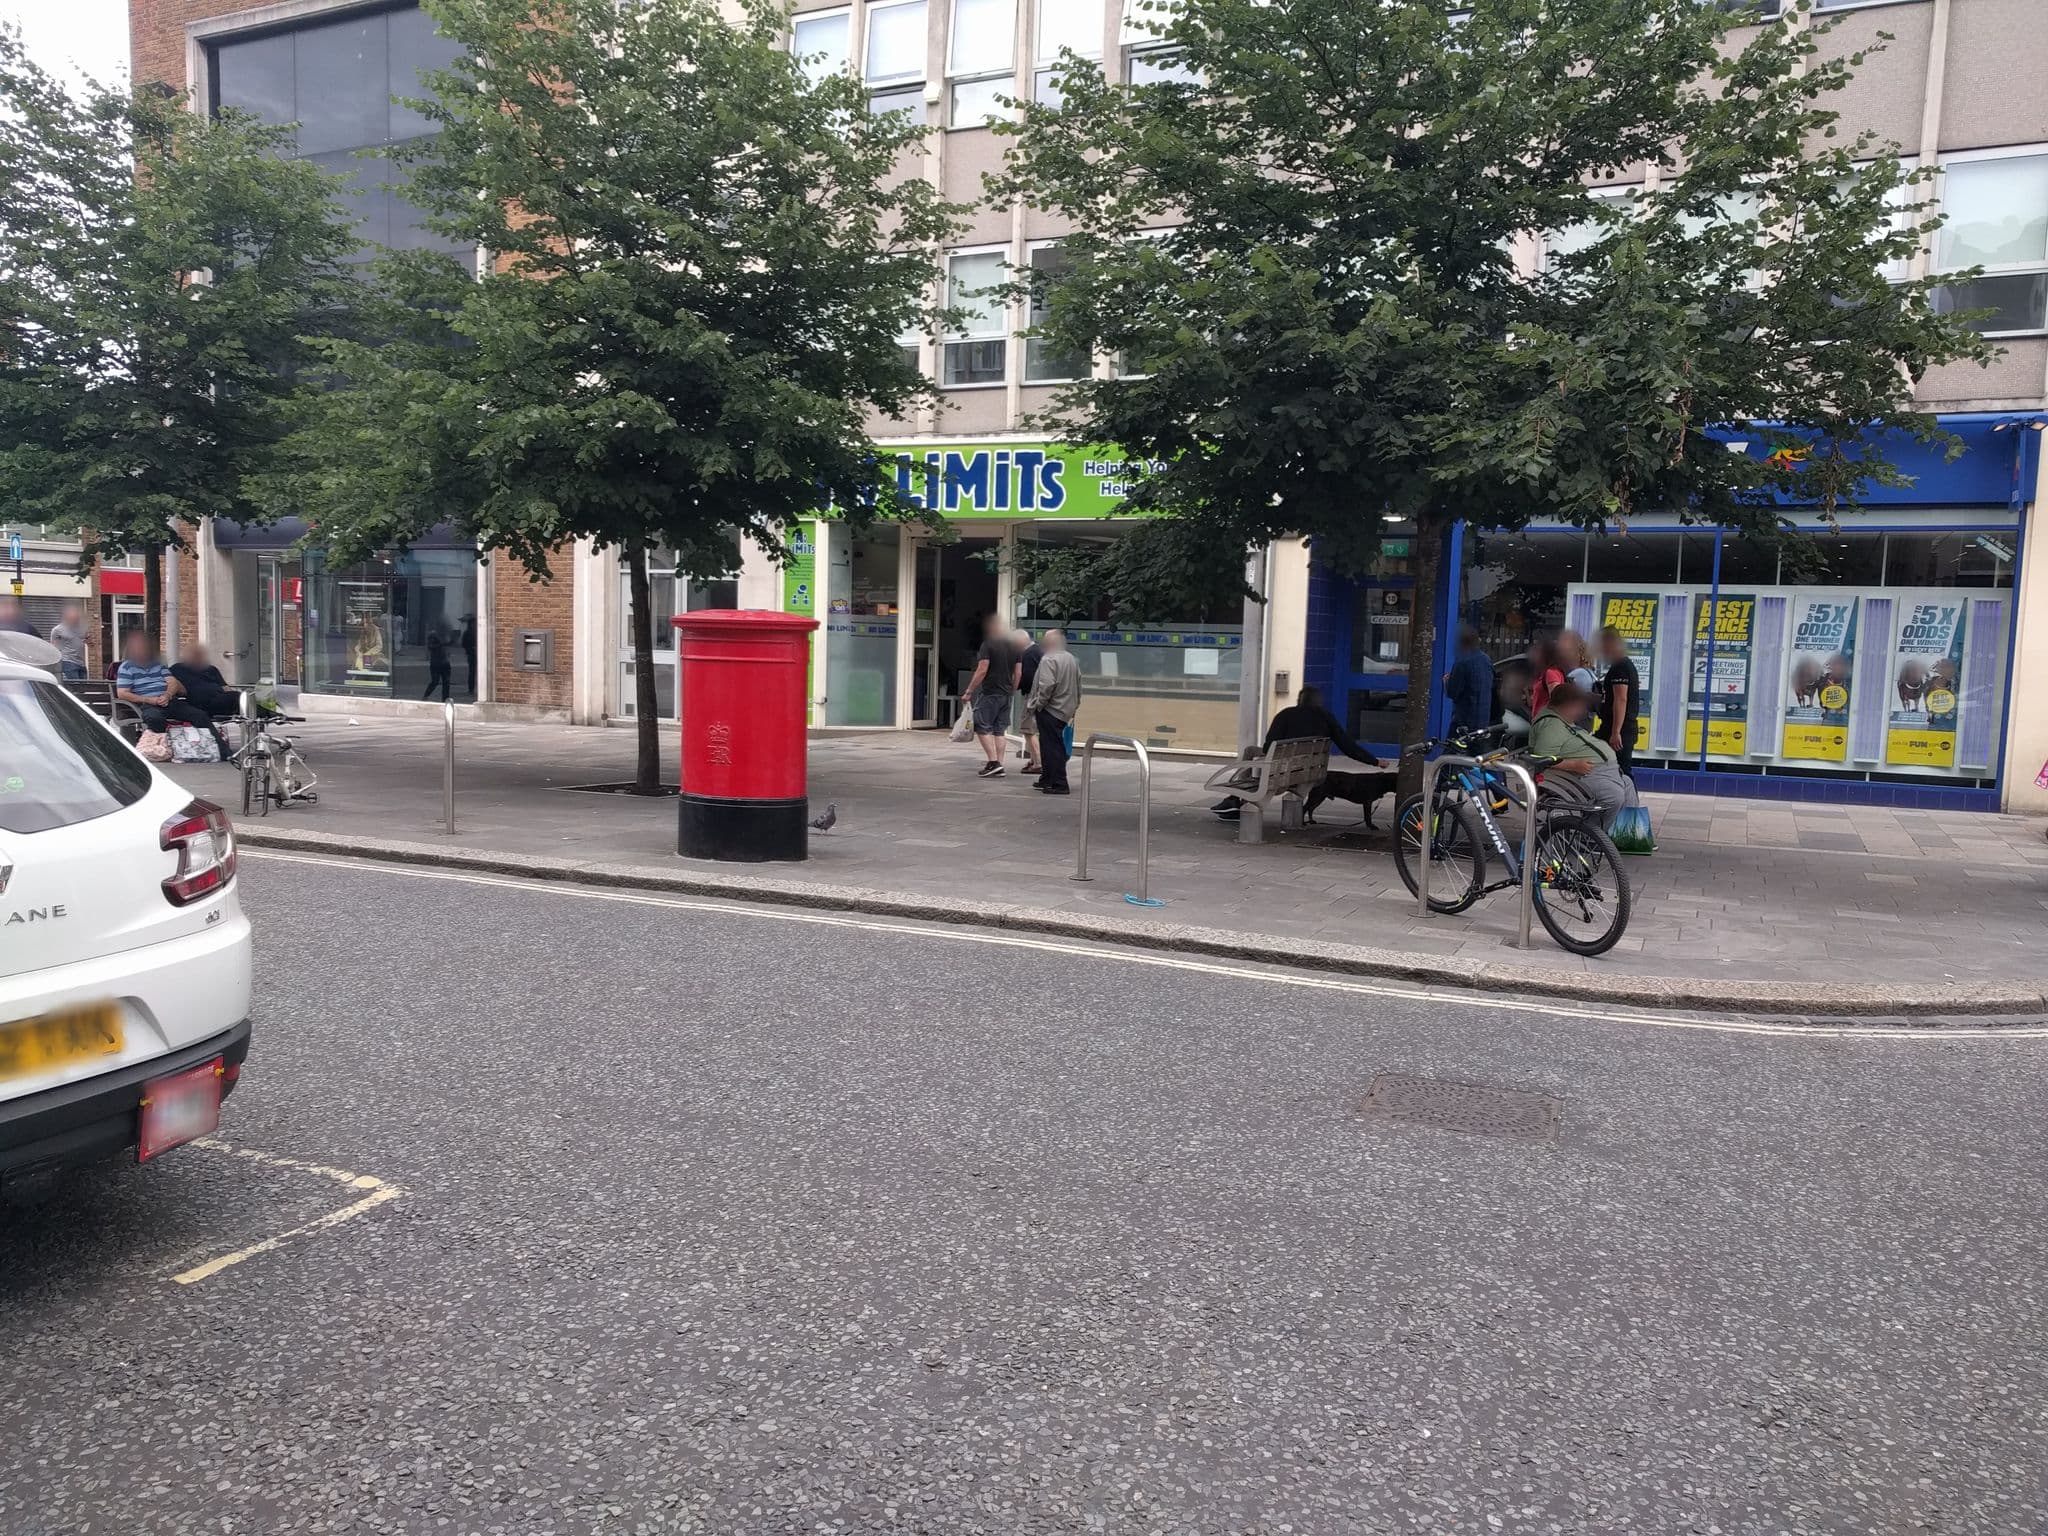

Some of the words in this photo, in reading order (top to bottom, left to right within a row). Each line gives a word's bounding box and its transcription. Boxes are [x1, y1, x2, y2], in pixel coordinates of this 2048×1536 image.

[1084, 460, 1143, 479] Helping
[1607, 598, 1658, 617] BEST
[1701, 600, 1754, 619] BEST
[1372, 616, 1404, 624] CORAL
[1603, 615, 1654, 631] PRICE
[1696, 617, 1750, 633] PRICE
[1695, 631, 1749, 641] GURANTEED
[1797, 623, 1844, 636] ODDS
[1902, 624, 1950, 639] ODDS
[1810, 636, 1841, 644] WINNER
[1900, 638, 1915, 646] ONE
[1916, 639, 1948, 647] WINNER
[1696, 660, 1708, 675] 2
[1804, 735, 1822, 743] FUN
[1909, 740, 1929, 748] FUN
